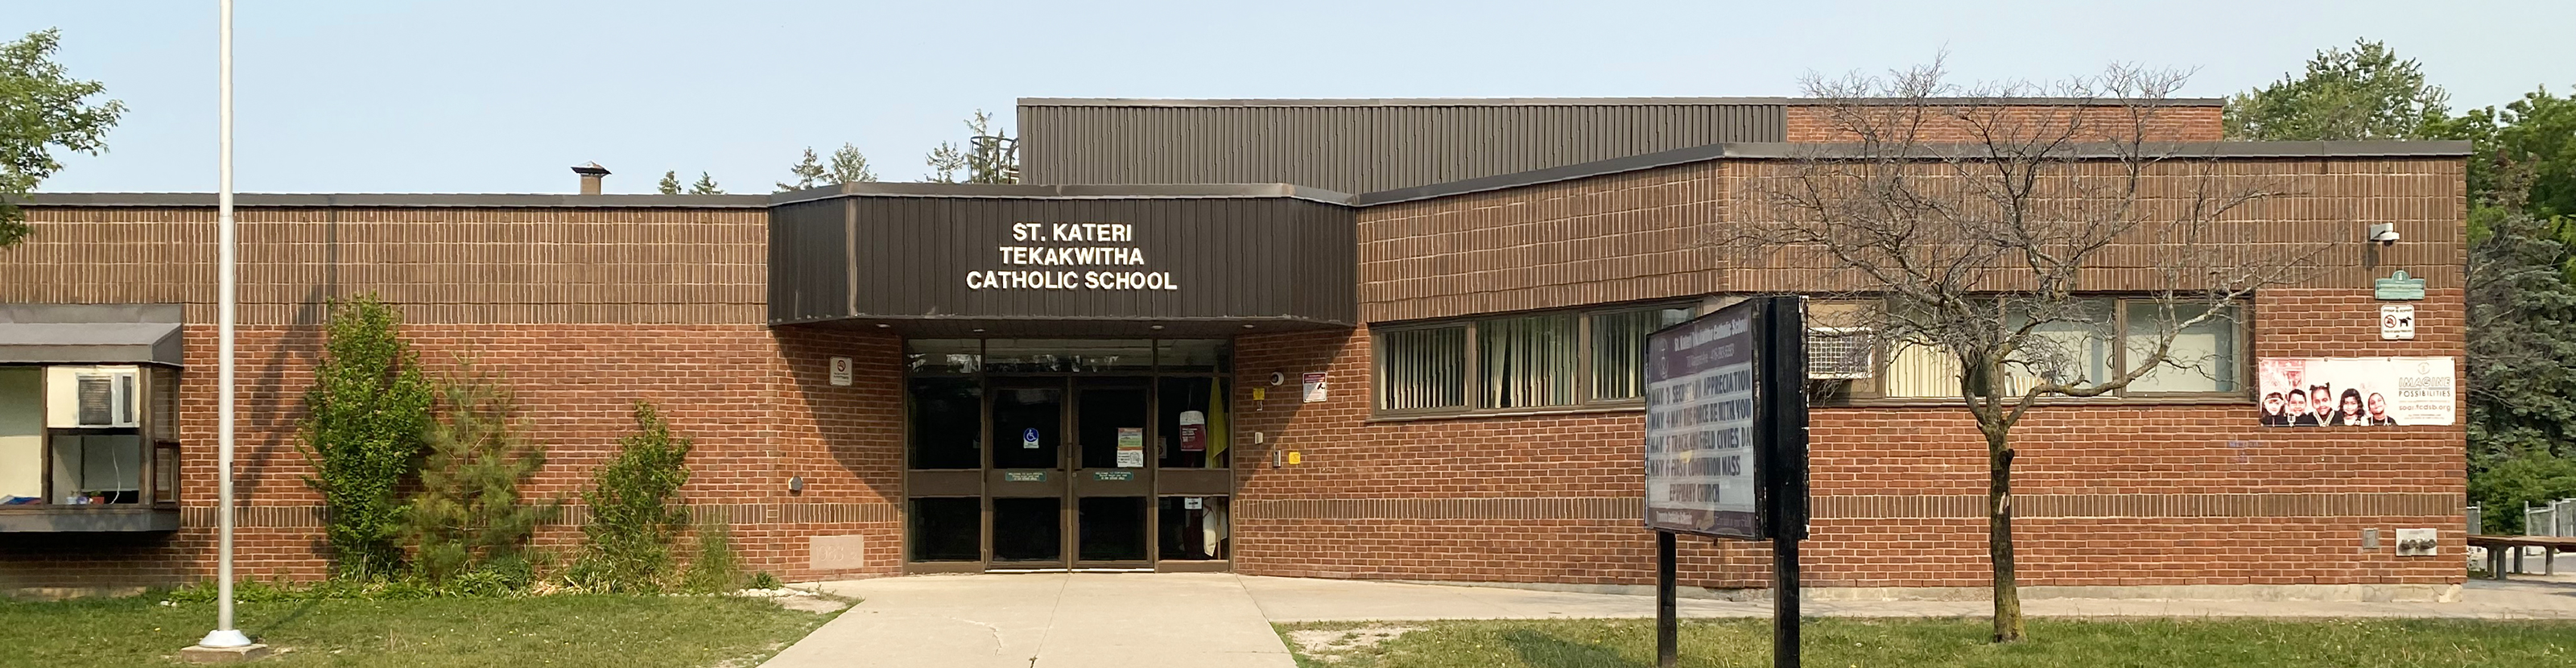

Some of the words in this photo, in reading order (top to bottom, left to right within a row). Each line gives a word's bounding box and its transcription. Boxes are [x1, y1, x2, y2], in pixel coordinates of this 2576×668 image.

[1012, 222, 1046, 241] ST.
[1053, 223, 1132, 241] KATERI
[999, 246, 1145, 266] TEKAKWITHA
[966, 270, 1079, 290] CATHOLIC
[1084, 271, 1178, 290] SCHOOL
[1652, 386, 1664, 406] MAY
[1666, 386, 1670, 405] 3
[1703, 369, 1751, 397] APPRECIATION
[2399, 376, 2450, 387] IMAGINE
[1652, 411, 1665, 430] MAY
[1671, 408, 1682, 428] MAY
[1693, 402, 1709, 426] FORCE
[1710, 402, 1718, 423] BE
[1735, 398, 1752, 419] YOU
[1650, 435, 1664, 453] MAY
[1666, 435, 1670, 452] 5
[1699, 430, 1715, 450] FIELD
[1716, 427, 1739, 449] CIVIES
[1650, 459, 1664, 477] MAY
[1721, 455, 1740, 476] MASS
